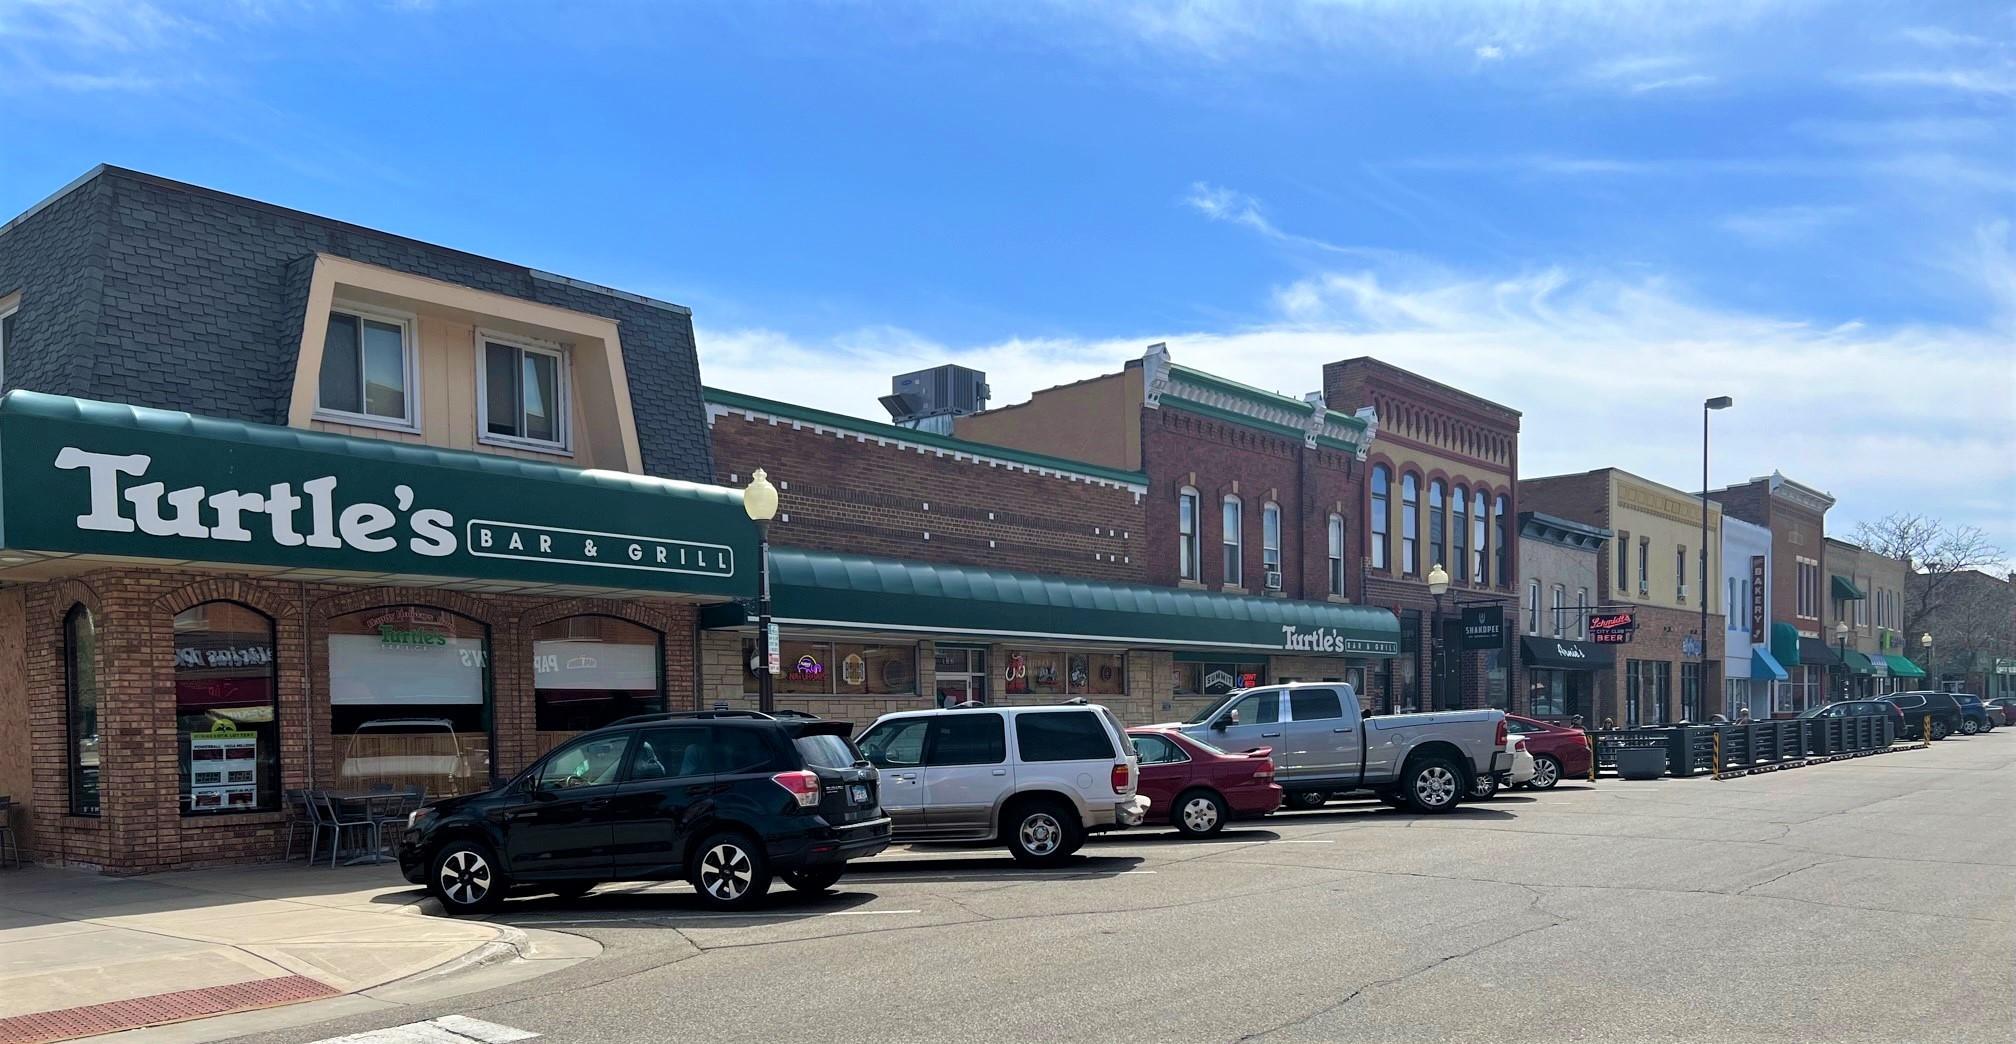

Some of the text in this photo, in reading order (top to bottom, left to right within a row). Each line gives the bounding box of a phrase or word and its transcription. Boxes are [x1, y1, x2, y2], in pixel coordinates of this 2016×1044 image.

[54, 446, 458, 557] Turtle's
[480, 528, 727, 569] BAR & GRILL
[1753, 567, 1762, 623] BAKERY
[379, 623, 447, 646] Turtle's
[1281, 625, 1345, 653] Turtle's
[1465, 625, 1500, 634] SHAKOPEE
[1596, 634, 1623, 642] BEER
[1205, 669, 1234, 688] SUMMIT
